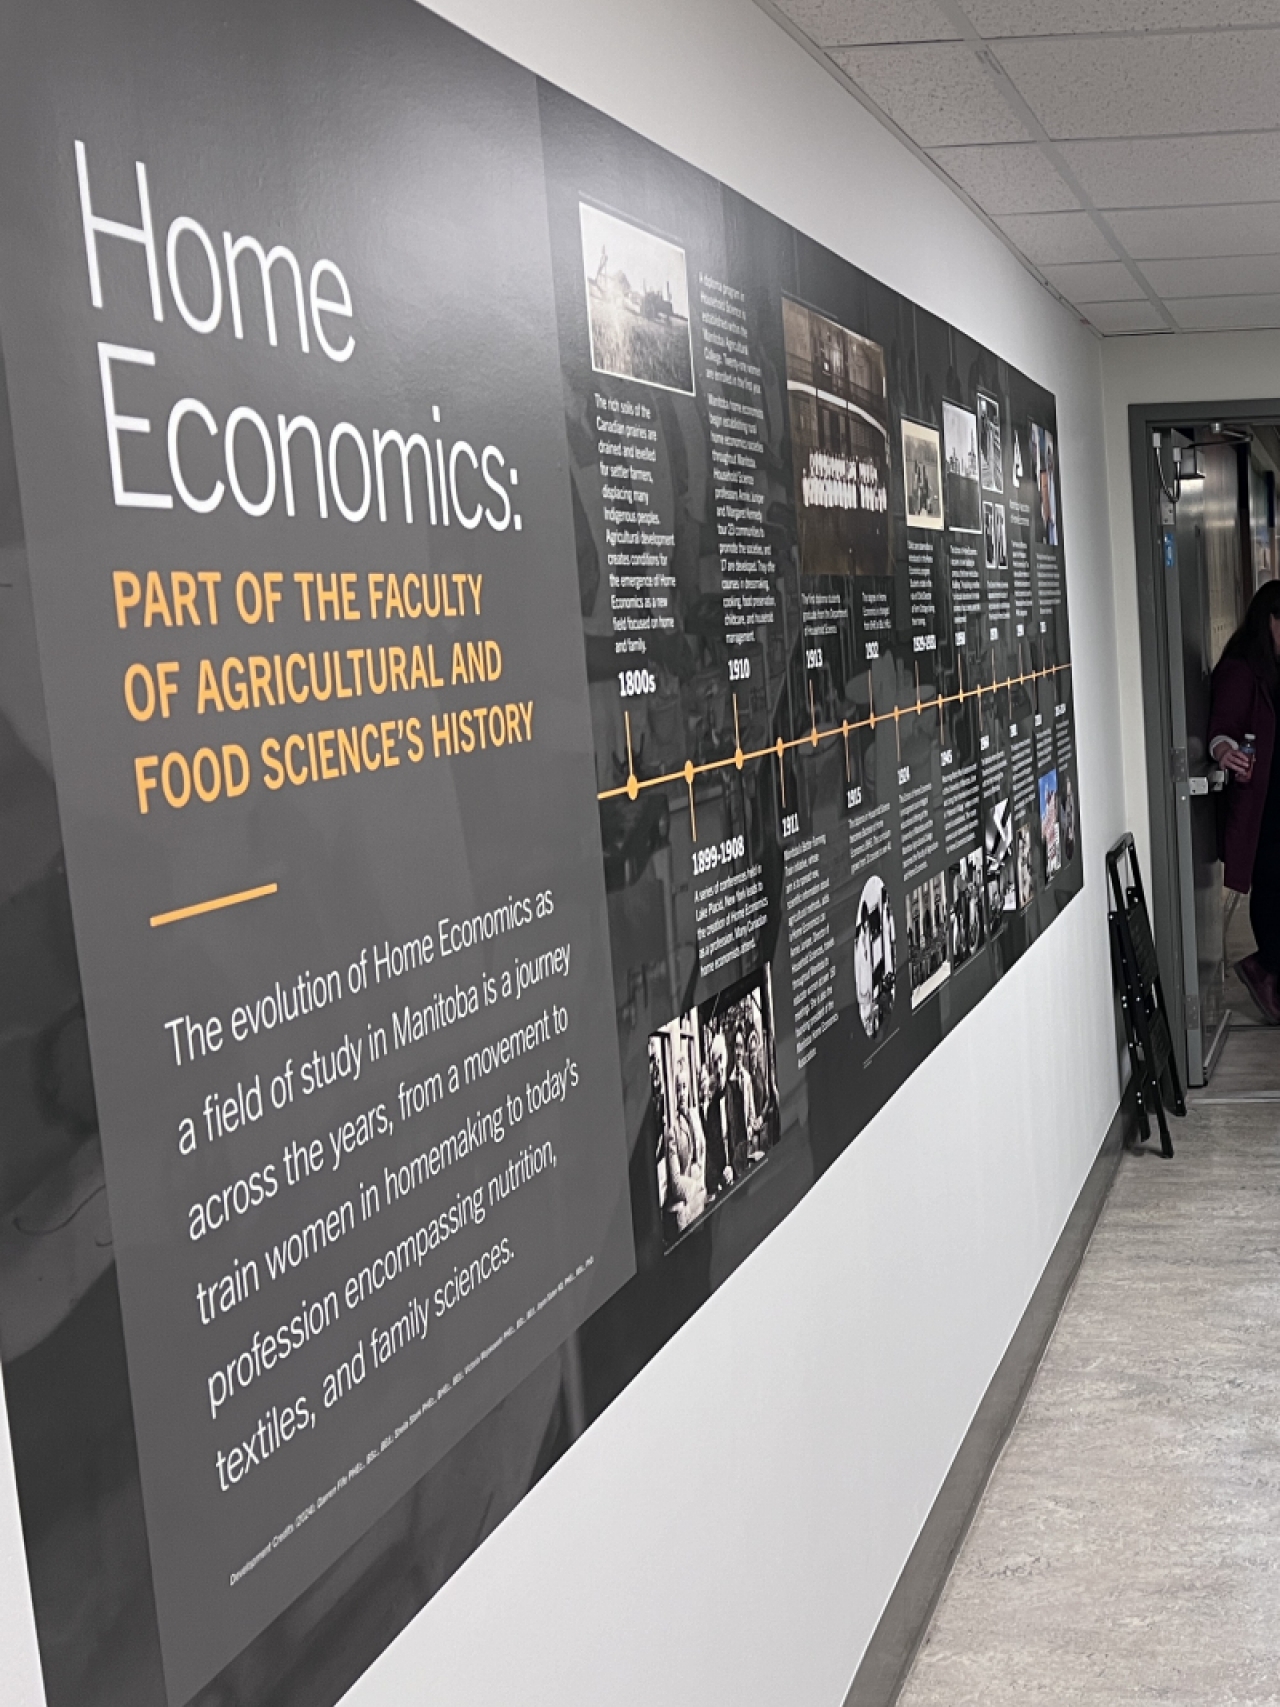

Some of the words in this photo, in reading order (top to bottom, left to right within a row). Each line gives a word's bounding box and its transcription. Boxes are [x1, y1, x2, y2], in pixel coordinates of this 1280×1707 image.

[74, 140, 355, 362] Home
[98, 342, 523, 531] Economics:
[112, 570, 221, 629] PART
[235, 571, 283, 624] OF
[293, 573, 361, 622] THE
[368, 573, 482, 620] FACULTY
[124, 662, 180, 722] OF
[196, 644, 444, 714] AGRICULTURAL
[451, 640, 502, 685] AND
[618, 668, 656, 697] 1800s
[728, 658, 750, 680] 1910
[134, 744, 251, 815] FOOD
[431, 701, 534, 757] HISTORY
[691, 834, 744, 876] 1899-1908
[164, 1014, 223, 1067] The
[230, 971, 341, 1041] evolution
[347, 949, 369, 993] of
[373, 934, 435, 984] Home
[438, 895, 532, 958] Economics
[535, 889, 554, 915] as
[177, 1116, 197, 1156] a
[203, 1075, 264, 1142] field
[270, 1059, 294, 1109] of
[300, 1035, 362, 1095] study
[367, 1022, 388, 1062] in
[391, 984, 480, 1050] Manitoba
[482, 972, 498, 1006] is
[500, 973, 512, 999] a
[514, 943, 570, 1000] journey
[188, 1164, 278, 1241] across
[283, 1138, 324, 1187] the
[329, 1104, 394, 1171] years,
[397, 1072, 443, 1121] from
[448, 1064, 460, 1093] a
[463, 1012, 550, 1084] movement
[553, 1004, 569, 1032] to
[197, 1259, 260, 1325] train
[265, 1201, 355, 1280] women
[359, 1182, 380, 1222] in
[384, 1106, 505, 1196] homemaking
[507, 1094, 523, 1123] to
[207, 1290, 339, 1419] profession
[344, 1186, 486, 1309] encompassing
[487, 1140, 557, 1206] nutrition,
[216, 1396, 316, 1492] textiles,
[322, 1341, 366, 1408] and
[370, 1297, 429, 1366] family
[433, 1237, 515, 1317] sciences.
